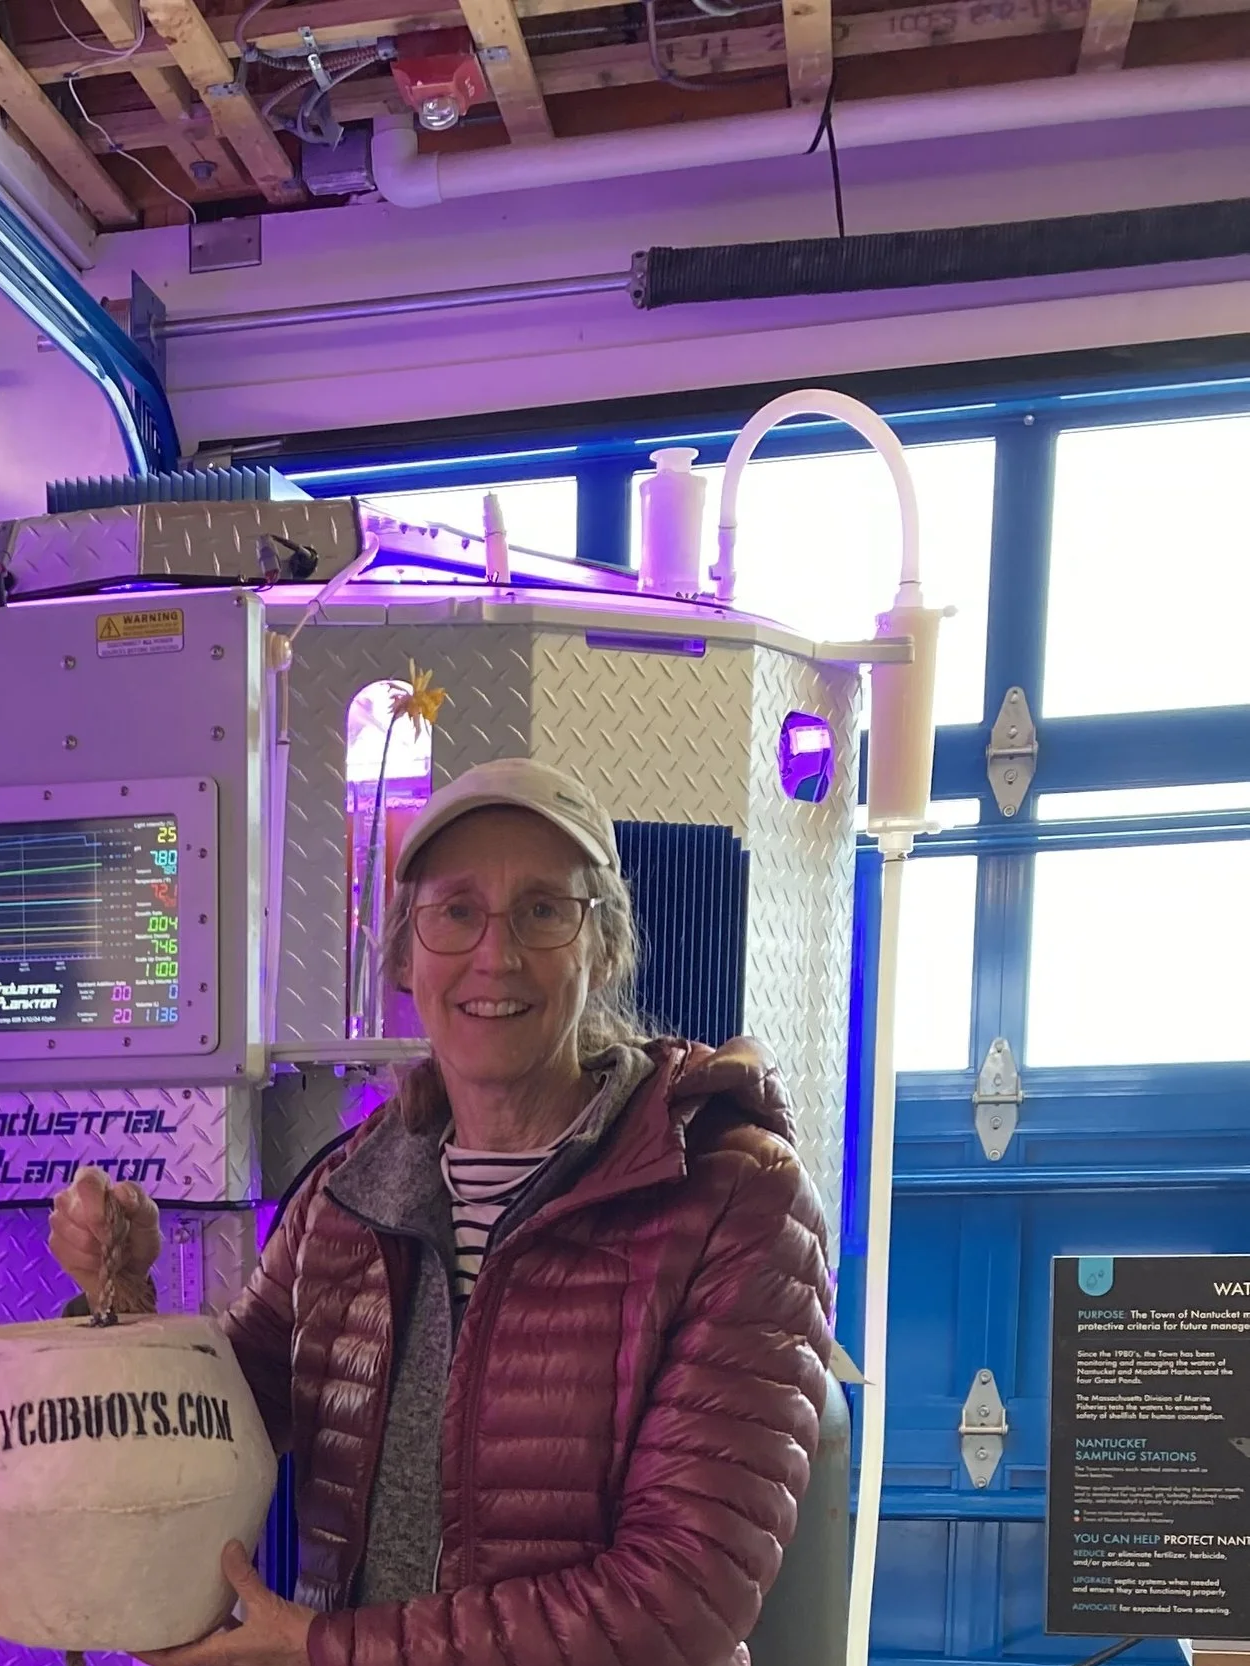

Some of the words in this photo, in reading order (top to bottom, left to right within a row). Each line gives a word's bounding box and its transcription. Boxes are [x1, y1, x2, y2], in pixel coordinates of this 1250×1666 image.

[123, 612, 178, 624] WARNING
[158, 827, 176, 843] 25
[169, 985, 178, 999] 0
[146, 1008, 178, 1022] 1136
[1213, 1282, 1250, 1296] WAT
[1130, 1310, 1147, 1319] The
[1150, 1310, 1175, 1319] Town
[1178, 1310, 1188, 1319] of
[1191, 1310, 1240, 1319] Nantucket
[1077, 1322, 1124, 1332] protective
[1127, 1322, 1160, 1330] criteria
[1163, 1322, 1177, 1330] for
[1180, 1322, 1207, 1330] future
[1077, 1359, 1117, 1368] monitoring
[1137, 1360, 1174, 1368] managing
[1218, 1359, 1226, 1367] of
[1076, 1394, 1089, 1402] The
[1091, 1394, 1142, 1402] Massachusetts
[1175, 1394, 1183, 1402] of
[1076, 1413, 1097, 1421] safety
[1076, 1439, 1148, 1448] NANTUCKET
[1075, 1451, 1136, 1461] SAMPLING
[1140, 1451, 1197, 1462] STATIONS
[1074, 1533, 1100, 1544] YOU
[1103, 1534, 1130, 1544] CAN
[1134, 1534, 1160, 1545] HELP
[1164, 1535, 1214, 1545] PROTECT
[1217, 1536, 1250, 1546] NANT
[1154, 1550, 1187, 1559] fertilizer,
[1190, 1551, 1227, 1560] herbicide,
[1073, 1559, 1100, 1567] and/or
[1102, 1560, 1135, 1568] pesticide
[1114, 1578, 1136, 1586] septic
[1138, 1578, 1166, 1587] systems
[1116, 1586, 1132, 1595] they
[1149, 1587, 1191, 1596] functioning
[1072, 1603, 1117, 1611] ADVOCATE
[1119, 1604, 1131, 1612] for
[1133, 1605, 1170, 1613] expanded
[1195, 1607, 1231, 1616] sewering.
